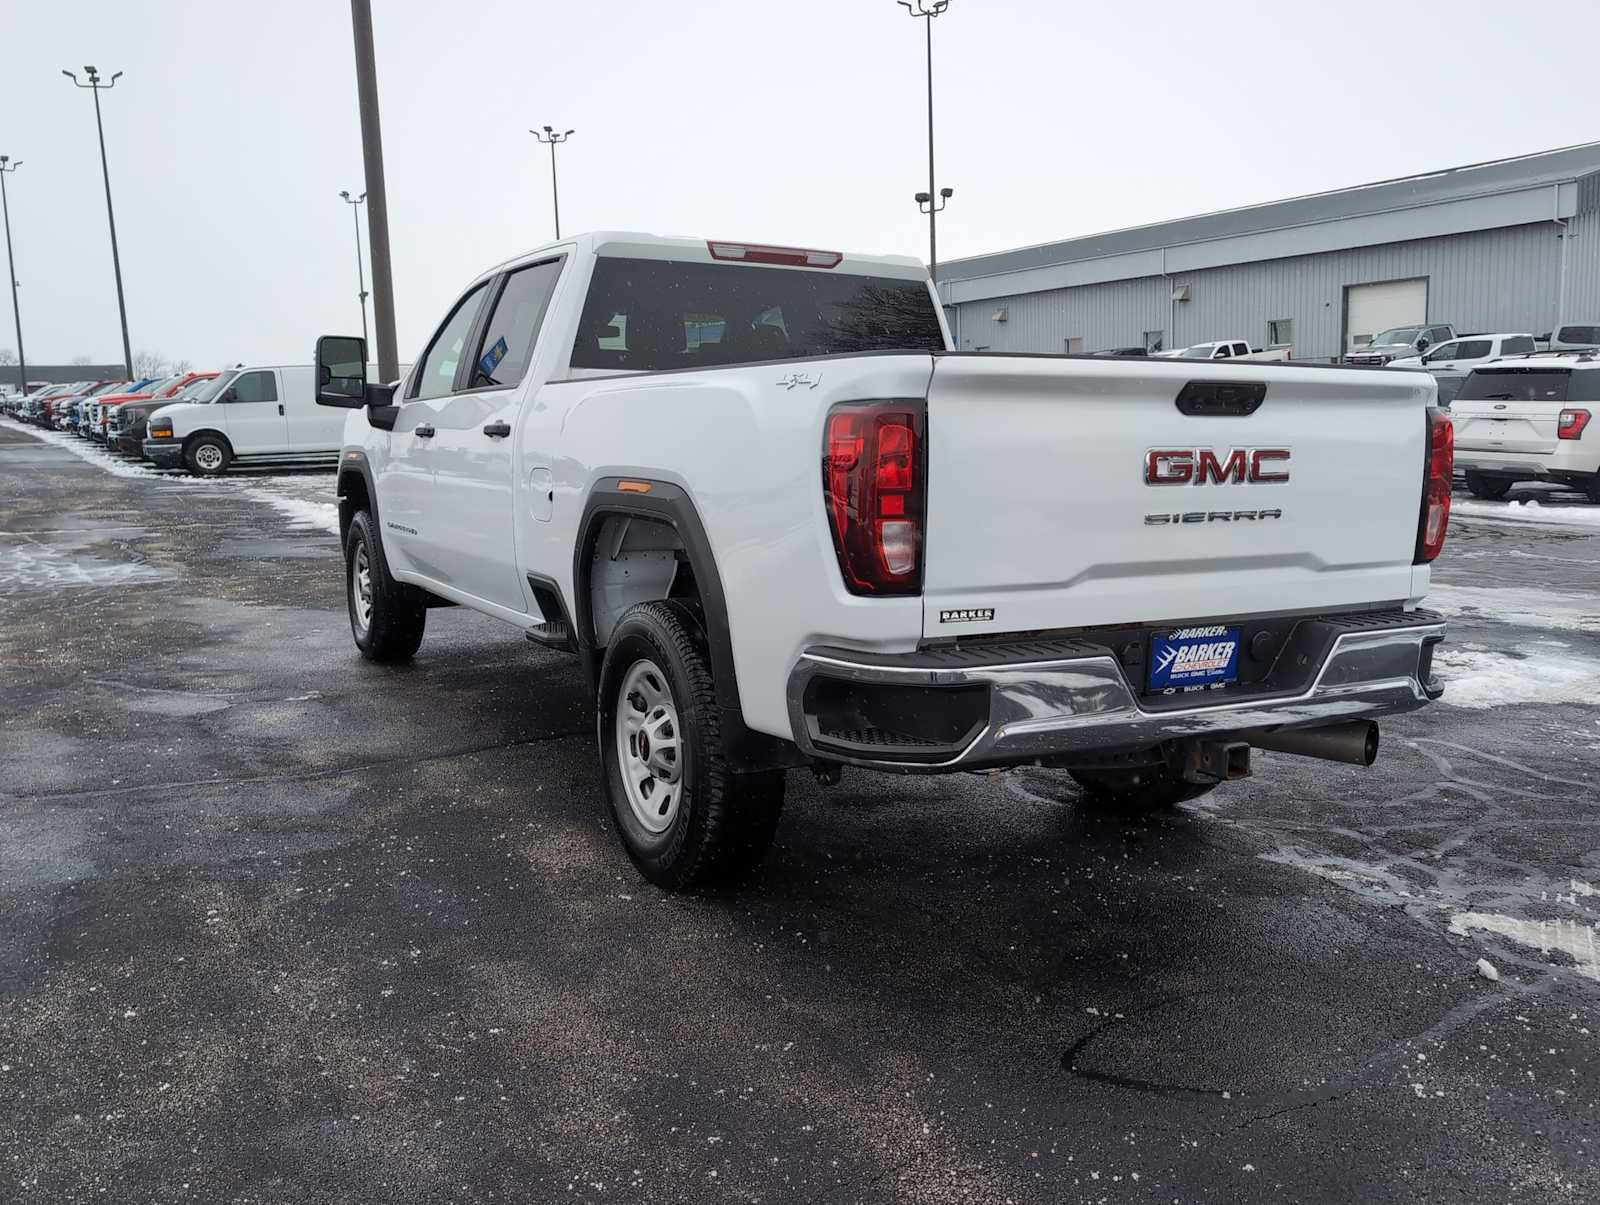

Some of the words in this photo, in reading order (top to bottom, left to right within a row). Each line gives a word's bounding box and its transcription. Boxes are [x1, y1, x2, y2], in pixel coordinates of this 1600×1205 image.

[1144, 446, 1292, 487] GMC
[1144, 508, 1282, 526] SIERRA
[942, 609, 992, 619] BARKER
[1178, 625, 1225, 640] BARKER
[1174, 641, 1236, 664] BARKER
[1170, 672, 1190, 680] BUICK
